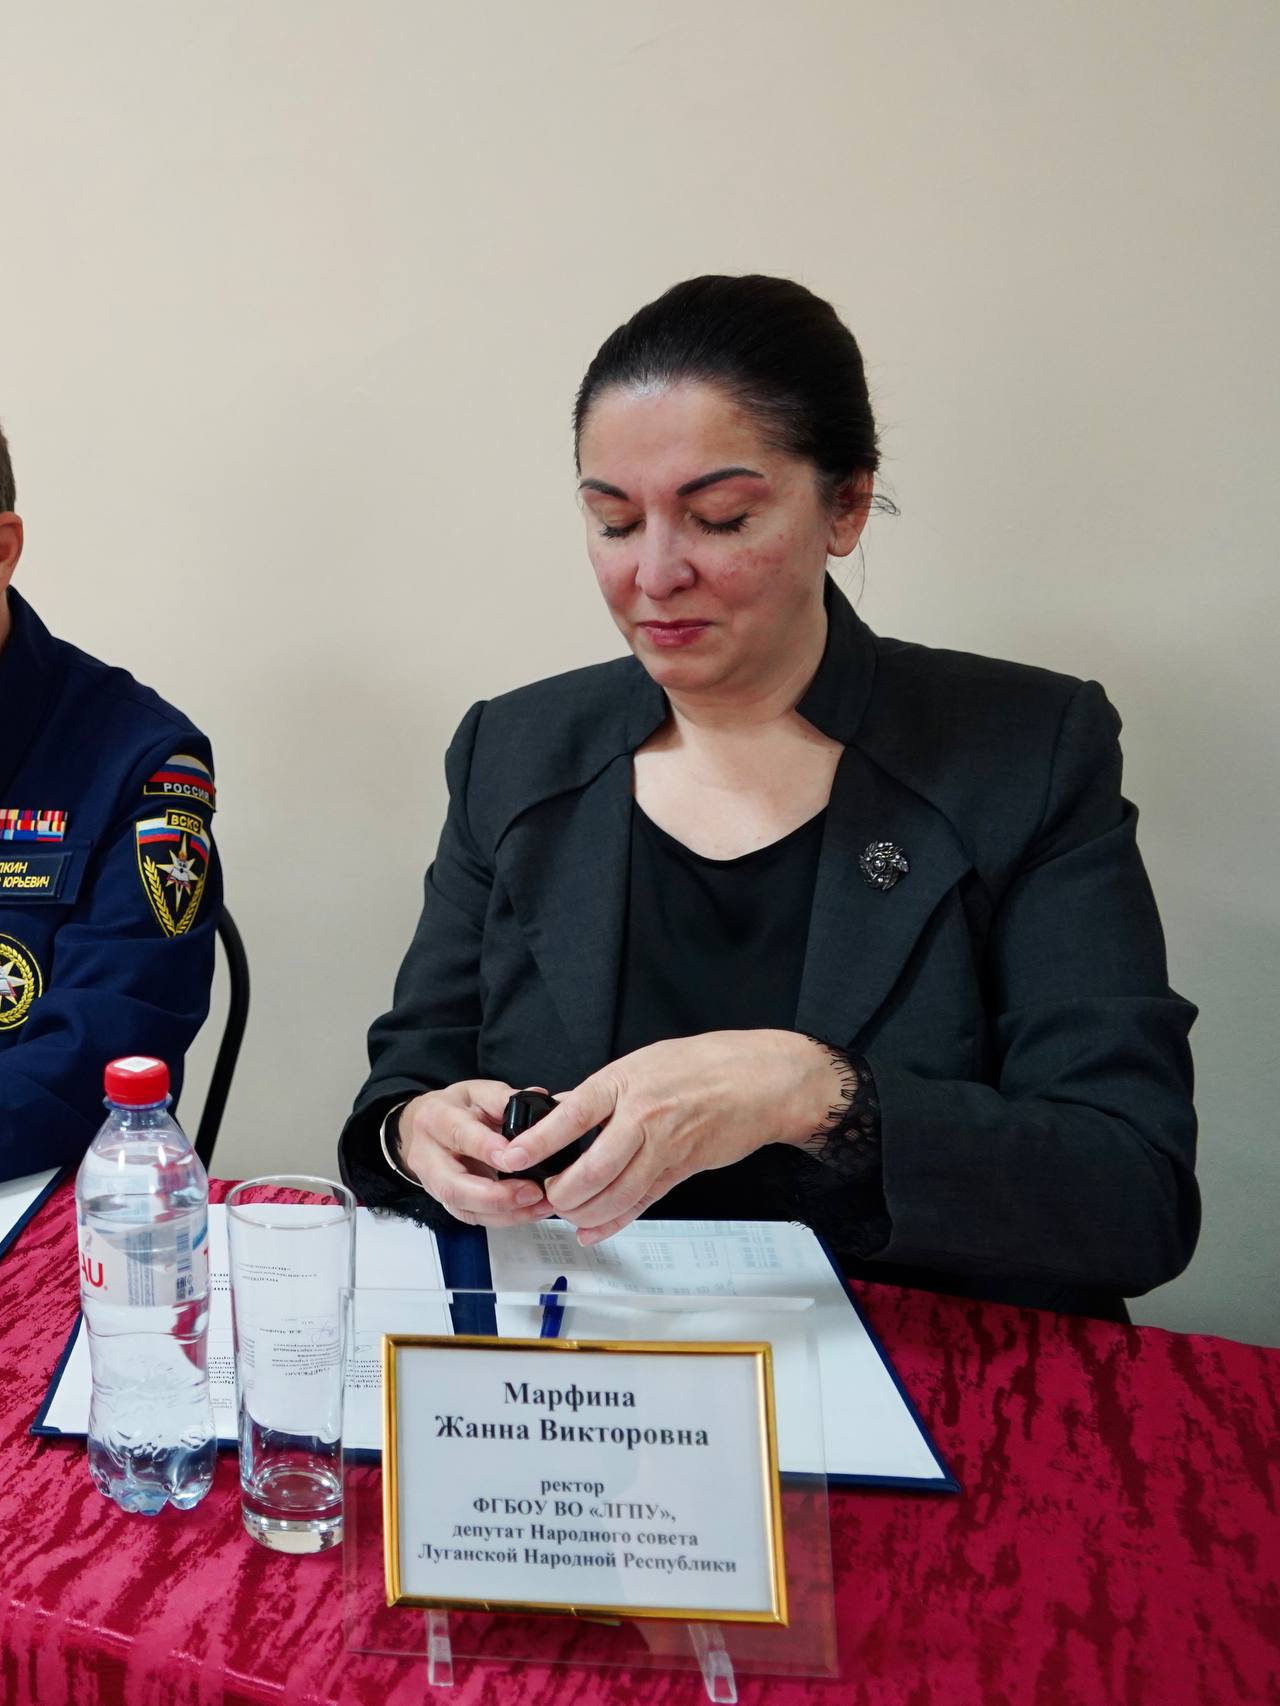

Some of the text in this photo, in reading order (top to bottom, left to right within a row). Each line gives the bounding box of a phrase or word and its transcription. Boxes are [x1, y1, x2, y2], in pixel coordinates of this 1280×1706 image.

[163, 782, 209, 800] РОССИЯ
[171, 814, 199, 830] ВСКС
[2, 875, 50, 888] ЮРЬЕВИЧ
[503, 1381, 636, 1412] Марфина
[435, 1414, 710, 1450] Жанна Викторовна
[541, 1479, 605, 1498] ректор
[473, 1498, 677, 1523] ФГБОУ ВО «ЛГПУ»,
[452, 1523, 699, 1547] депутат Народного совета
[418, 1543, 737, 1575] Луганской Народной Республики
